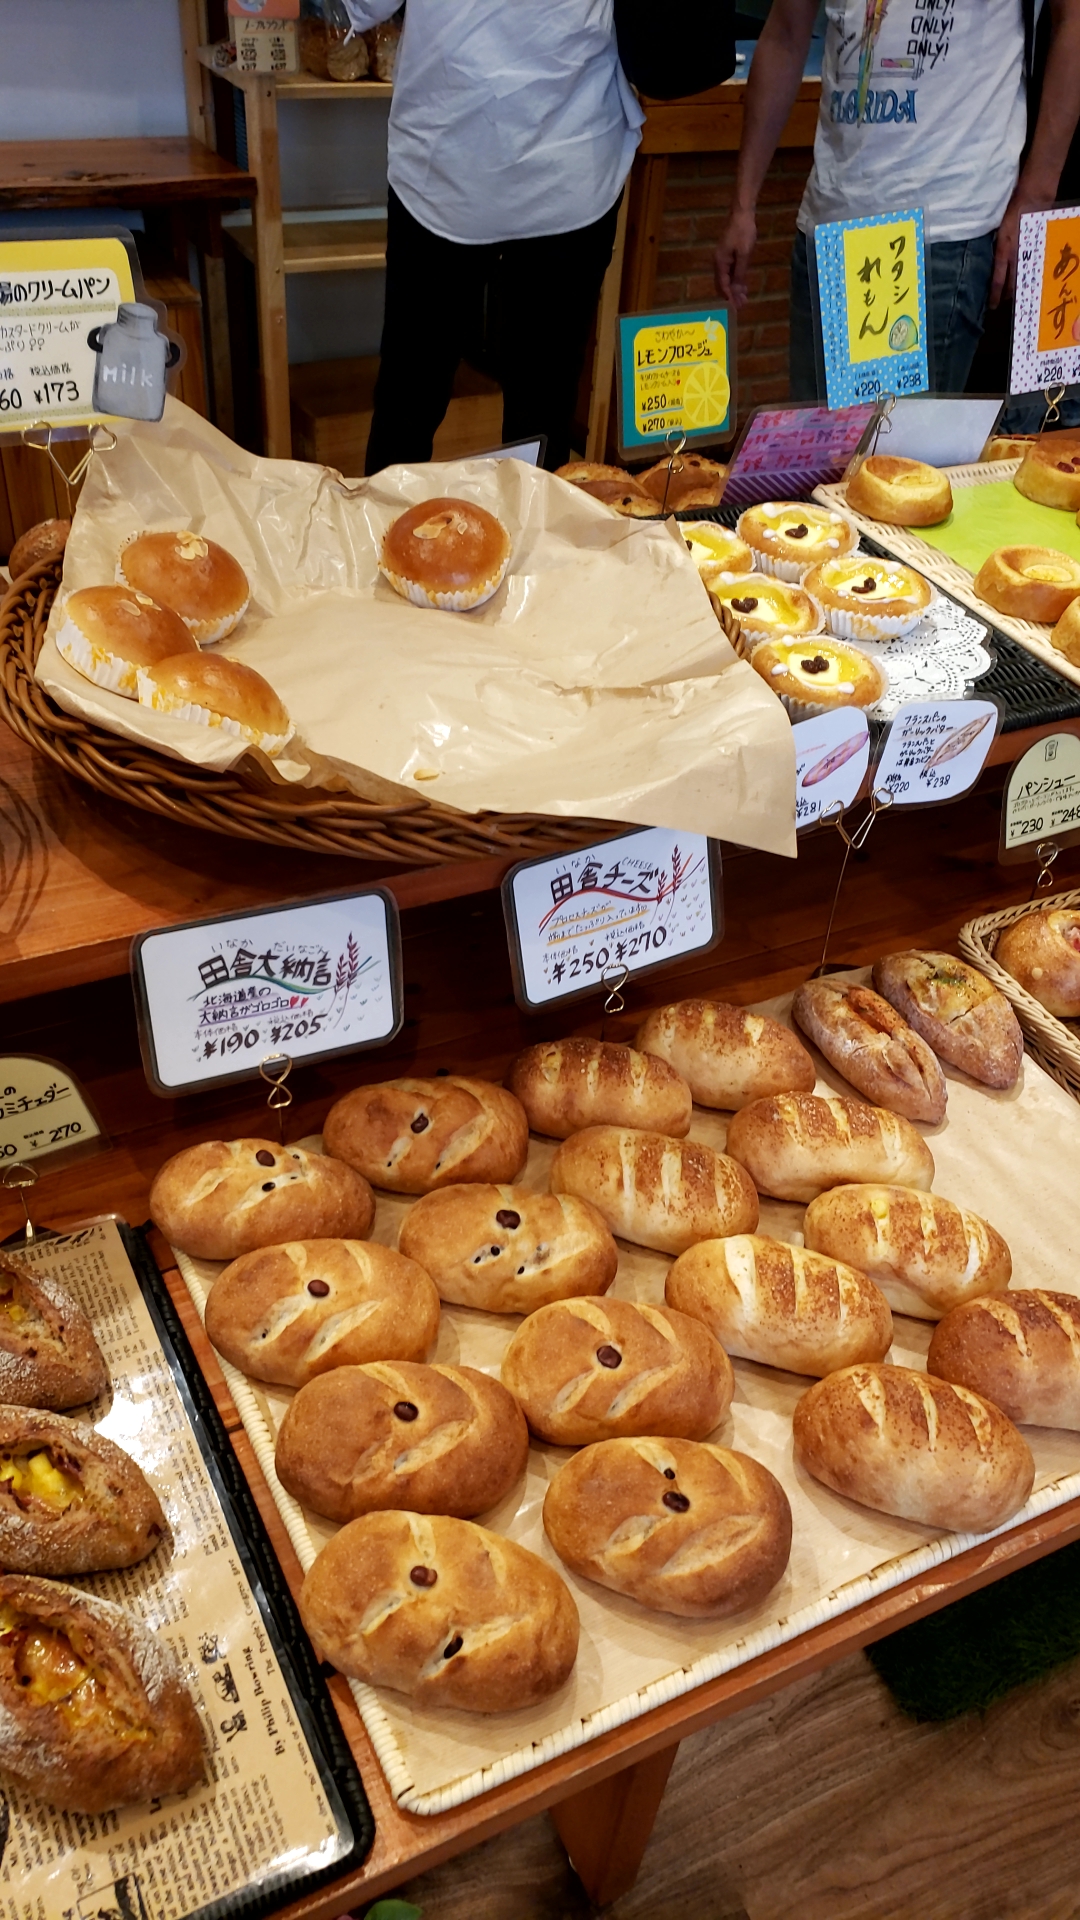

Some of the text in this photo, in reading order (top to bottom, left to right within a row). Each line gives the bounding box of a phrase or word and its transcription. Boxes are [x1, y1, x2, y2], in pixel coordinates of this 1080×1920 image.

[911, 16, 955, 42] ONLY!
[907, 38, 949, 69] ONLY!
[889, 235, 910, 305] ワタシ
[857, 256, 890, 340] れもん
[1047, 242, 1080, 340] あんず
[638, 339, 713, 366] レモンフロマージュ
[102, 364, 154, 388] Milk
[855, 379, 881, 397] ¥220
[897, 373, 922, 389] ¥238
[1037, 366, 1063, 383] ¥220
[34, 380, 80, 404] ¥173
[642, 394, 667, 411] ¥250
[643, 417, 666, 433] ¥270
[905, 711, 948, 725] フランスパンの
[902, 725, 954, 736] ガーリックバター
[888, 774, 950, 793] ¥220 ¥238
[1017, 774, 1076, 800] パンシュー
[796, 800, 822, 819] ¥281
[556, 854, 596, 874] いなか
[622, 856, 654, 870] CHEESE
[551, 861, 659, 905] 田舎チーズ
[605, 922, 645, 942] 税込価格
[211, 939, 254, 953] いなか
[274, 941, 327, 955] だいなごん
[552, 926, 667, 985] ¥250 ¥270
[198, 948, 332, 989] 田舎大納言
[203, 986, 271, 1007] 北海道産の
[200, 998, 290, 1024] 大納言がゴロゴロ
[194, 1023, 238, 1040] 本体価格
[203, 1013, 328, 1059] ¥190 ¥205
[235, 1579, 254, 1616] Congress
[250, 1618, 269, 1652] People's
[238, 1645, 265, 1696] Bowring
[257, 1697, 281, 1735] Philip
[271, 1737, 288, 1755] By
